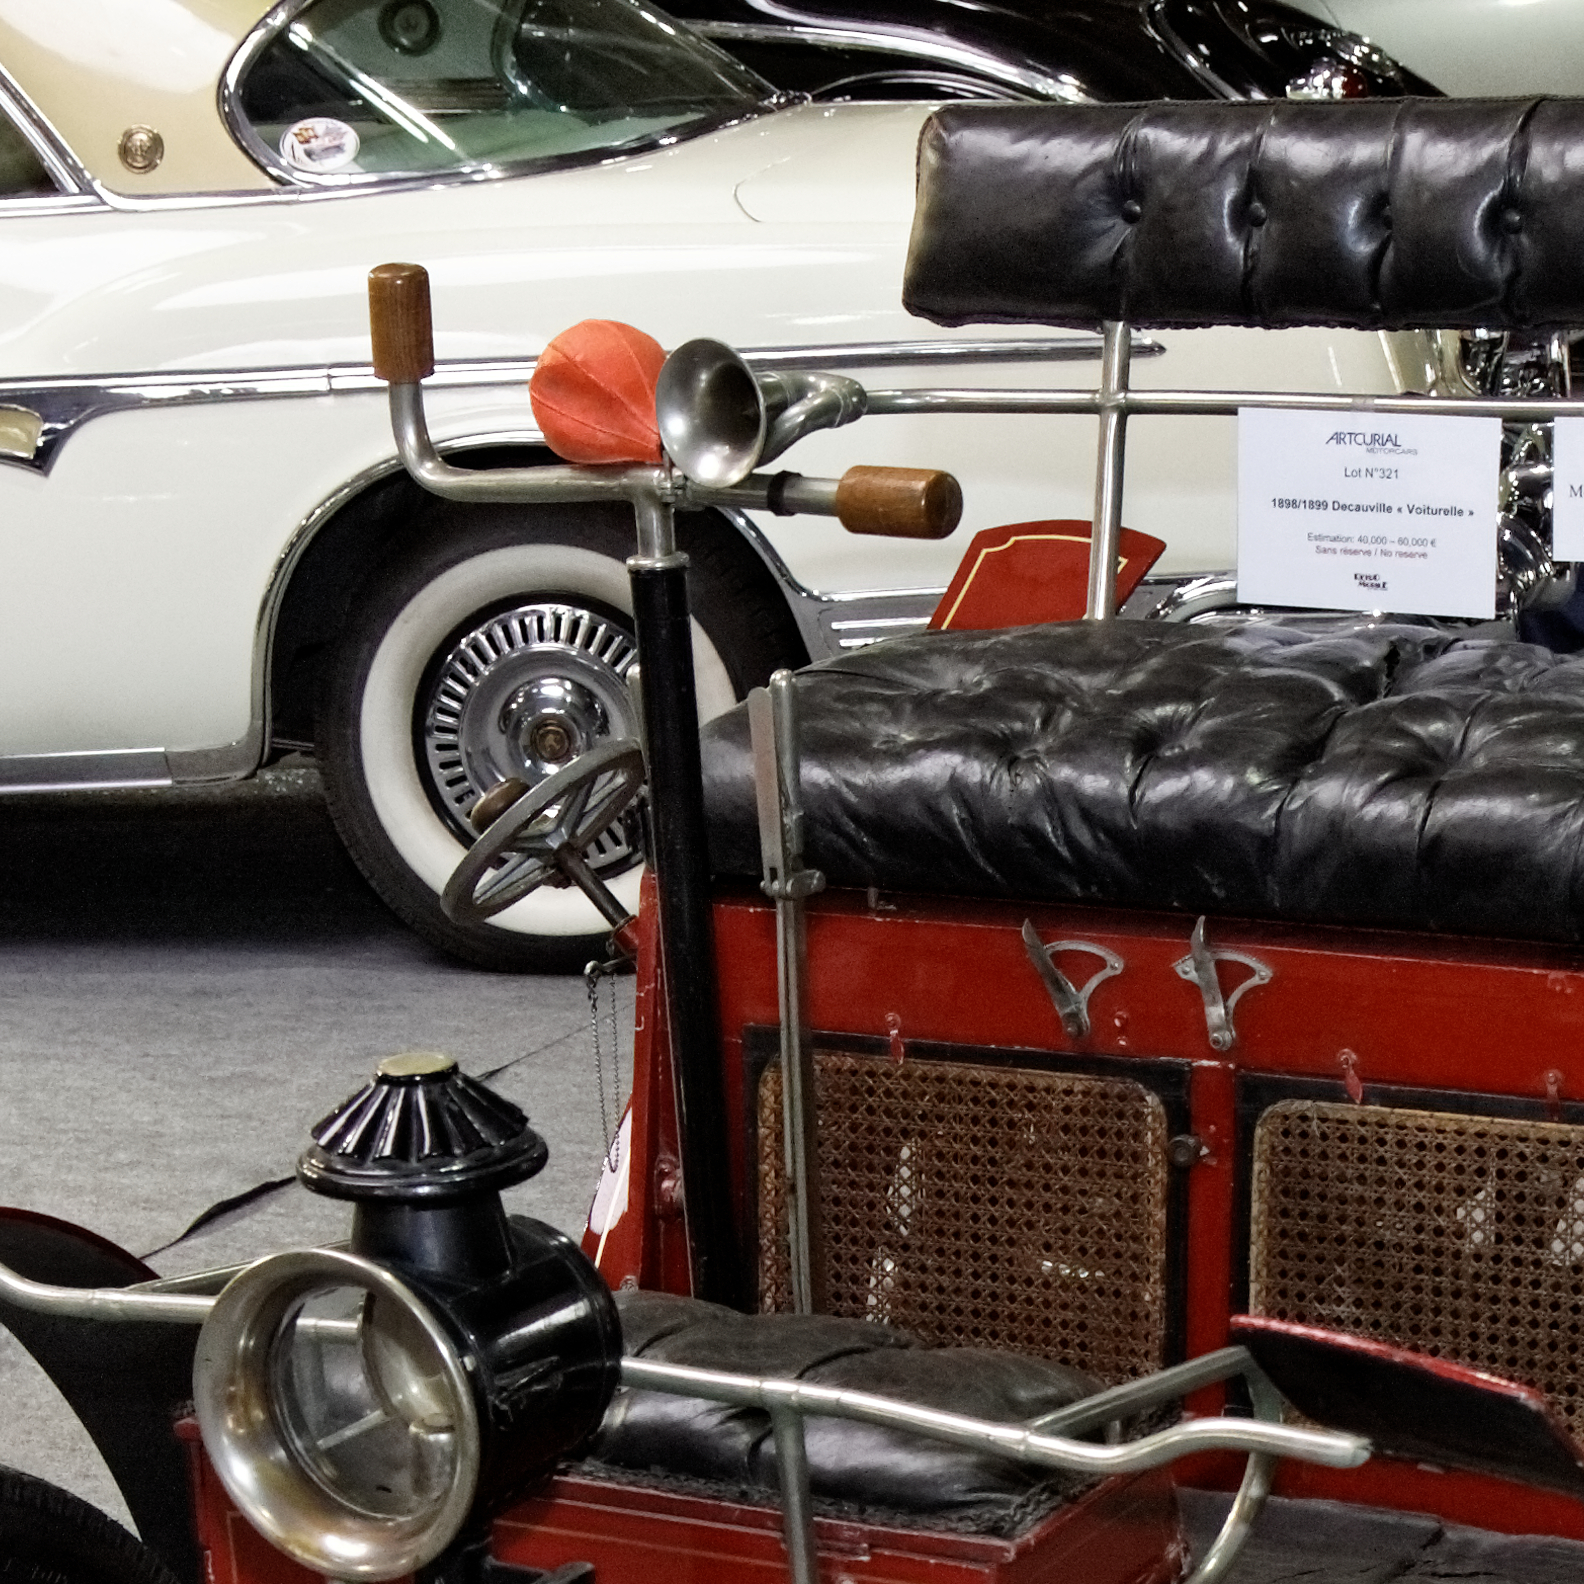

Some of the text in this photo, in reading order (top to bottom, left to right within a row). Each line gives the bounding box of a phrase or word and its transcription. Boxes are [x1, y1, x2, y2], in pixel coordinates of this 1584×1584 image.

[1325, 431, 1402, 447] ARTCURIAL
[1344, 466, 1399, 480] Lot N°321
[1272, 498, 1329, 511] 1898/1899
[1332, 500, 1393, 514] Decauville
[1407, 504, 1464, 517] Voiturelle
[1307, 532, 1354, 544] Estimation:
[1315, 545, 1337, 555] Sans
[1380, 549, 1393, 558] No
